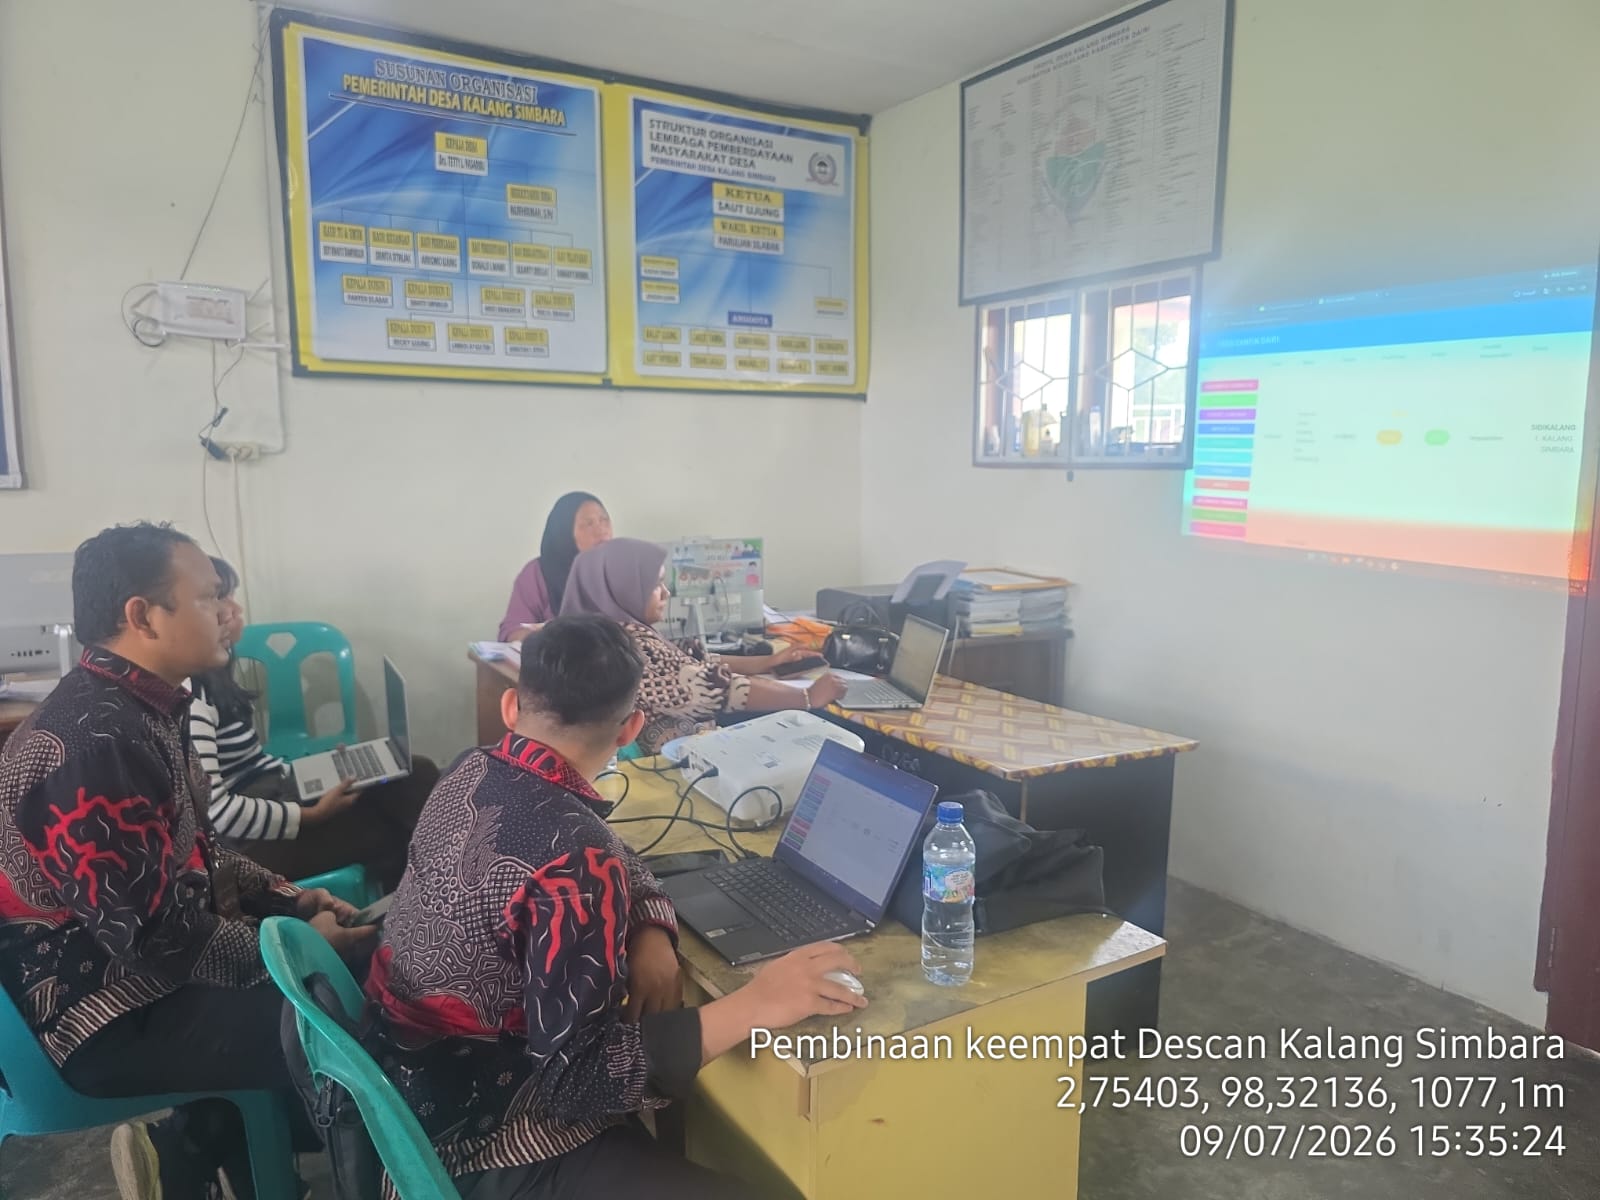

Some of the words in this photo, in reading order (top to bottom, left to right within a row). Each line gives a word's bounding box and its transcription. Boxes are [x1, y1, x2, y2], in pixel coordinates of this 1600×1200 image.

[375, 59, 447, 88] SUSUNAN
[450, 72, 538, 104] ORGANISASI
[343, 74, 427, 105] PEMERINTAH
[429, 88, 460, 109] DESA
[463, 95, 514, 120] KALANG
[515, 105, 566, 126] SIMBARA
[649, 119, 708, 138] STRUKTUR
[709, 129, 774, 149] ORGANISASI
[649, 131, 705, 149] LEMBAGA
[707, 139, 794, 164] PEMBERDAYAAN
[649, 143, 728, 166] MASYARAKAT
[729, 156, 756, 170] DESA
[650, 157, 698, 171] PEMERINTAH
[699, 163, 716, 174] DESA
[718, 167, 746, 179] KALANG
[725, 186, 772, 204] KETUA
[745, 206, 780, 220] UJUNG
[720, 221, 749, 235] WAKIL
[750, 225, 778, 239] KETUA
[1530, 423, 1577, 432] SIDIKALANG
